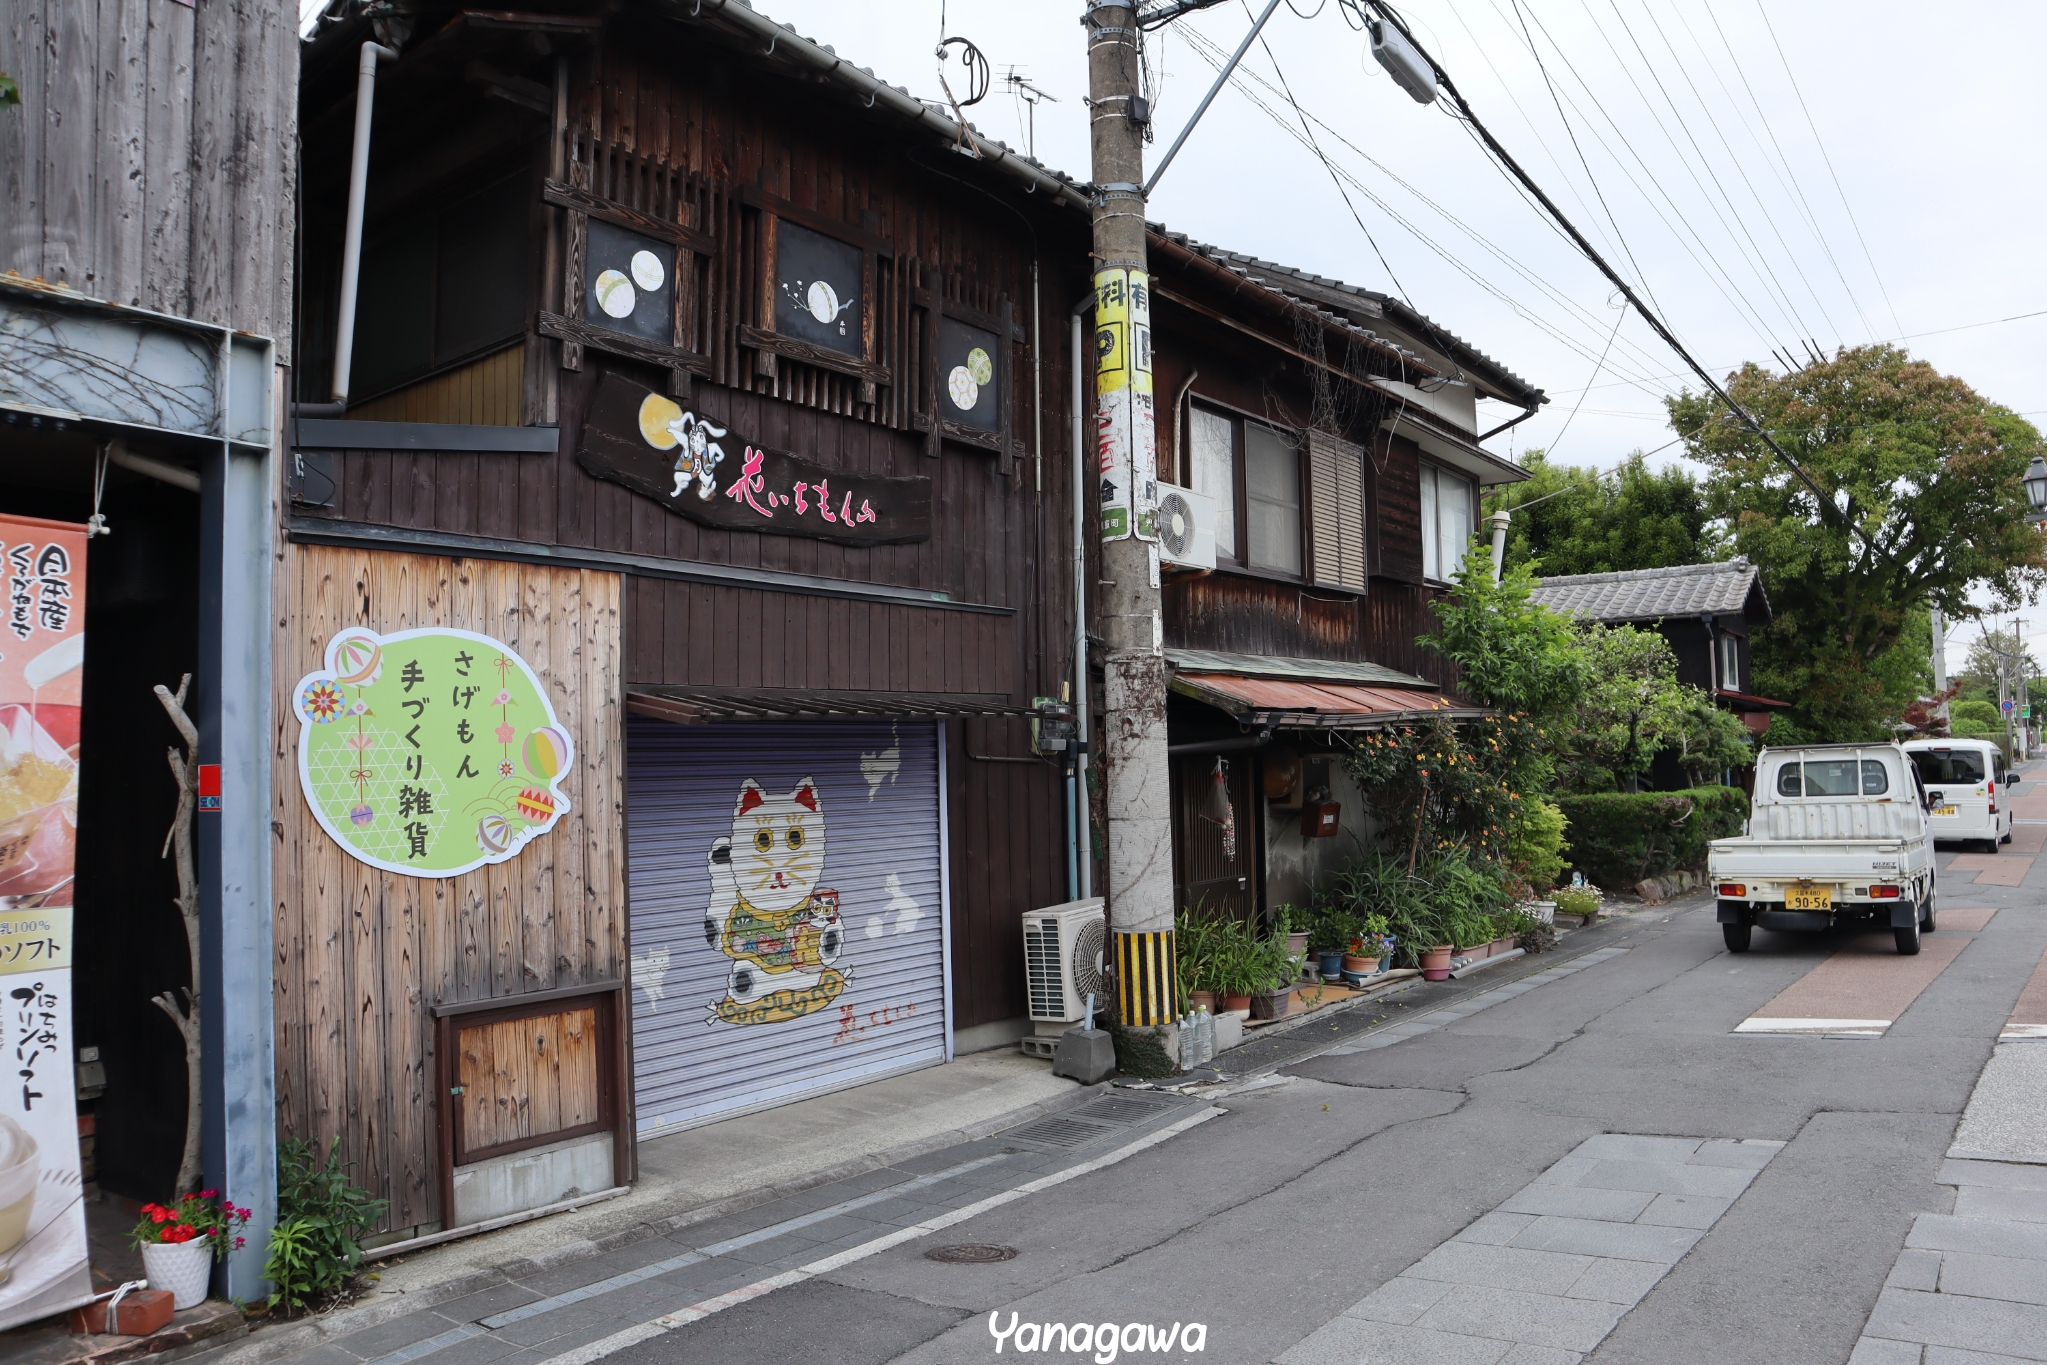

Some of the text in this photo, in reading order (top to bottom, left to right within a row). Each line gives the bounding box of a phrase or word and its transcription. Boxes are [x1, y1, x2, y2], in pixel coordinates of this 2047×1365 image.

[38, 545, 70, 631] 日本産
[452, 650, 481, 779] さげもん
[398, 659, 434, 860] 手づくり雑貨
[200, 797, 220, 807] SECOM
[1795, 897, 1828, 908] 90-56
[0, 937, 61, 963] ソフト
[10, 982, 44, 1111] プリンソフト
[38, 993, 58, 1053] はちみつ
